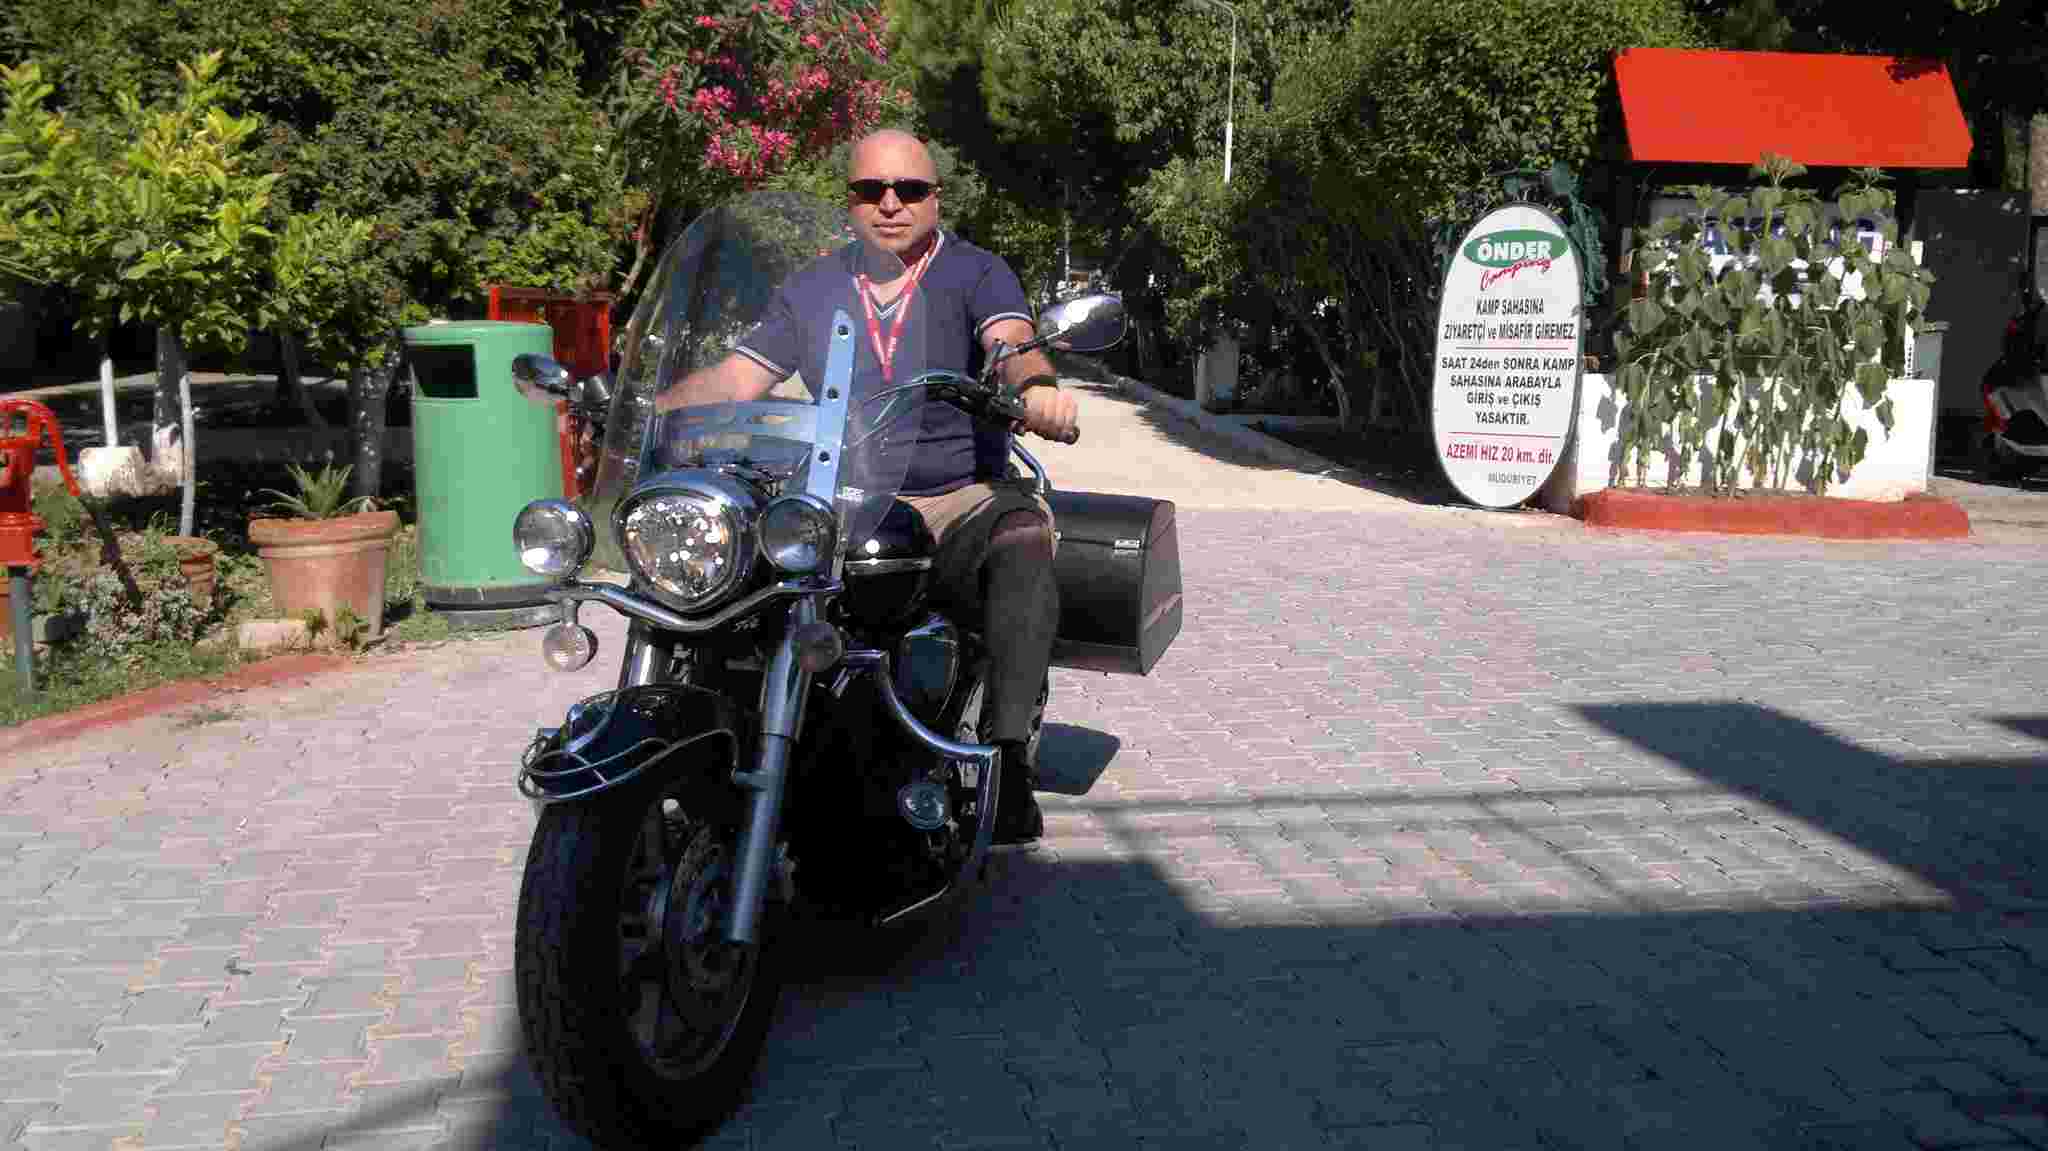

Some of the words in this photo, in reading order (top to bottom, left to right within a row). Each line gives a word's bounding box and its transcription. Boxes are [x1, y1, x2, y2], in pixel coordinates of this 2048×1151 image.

[1476, 299, 1499, 315] KAMP
[1488, 327, 1497, 339] ve
[1441, 357, 1467, 369] SAAT
[1503, 357, 1540, 370] SONRA
[1542, 358, 1575, 371] KAMP
[1450, 374, 1501, 387] SAHASINA
[1504, 375, 1561, 389] ARABAYLA
[1497, 395, 1510, 405] ve
[1501, 446, 1514, 462] 20
